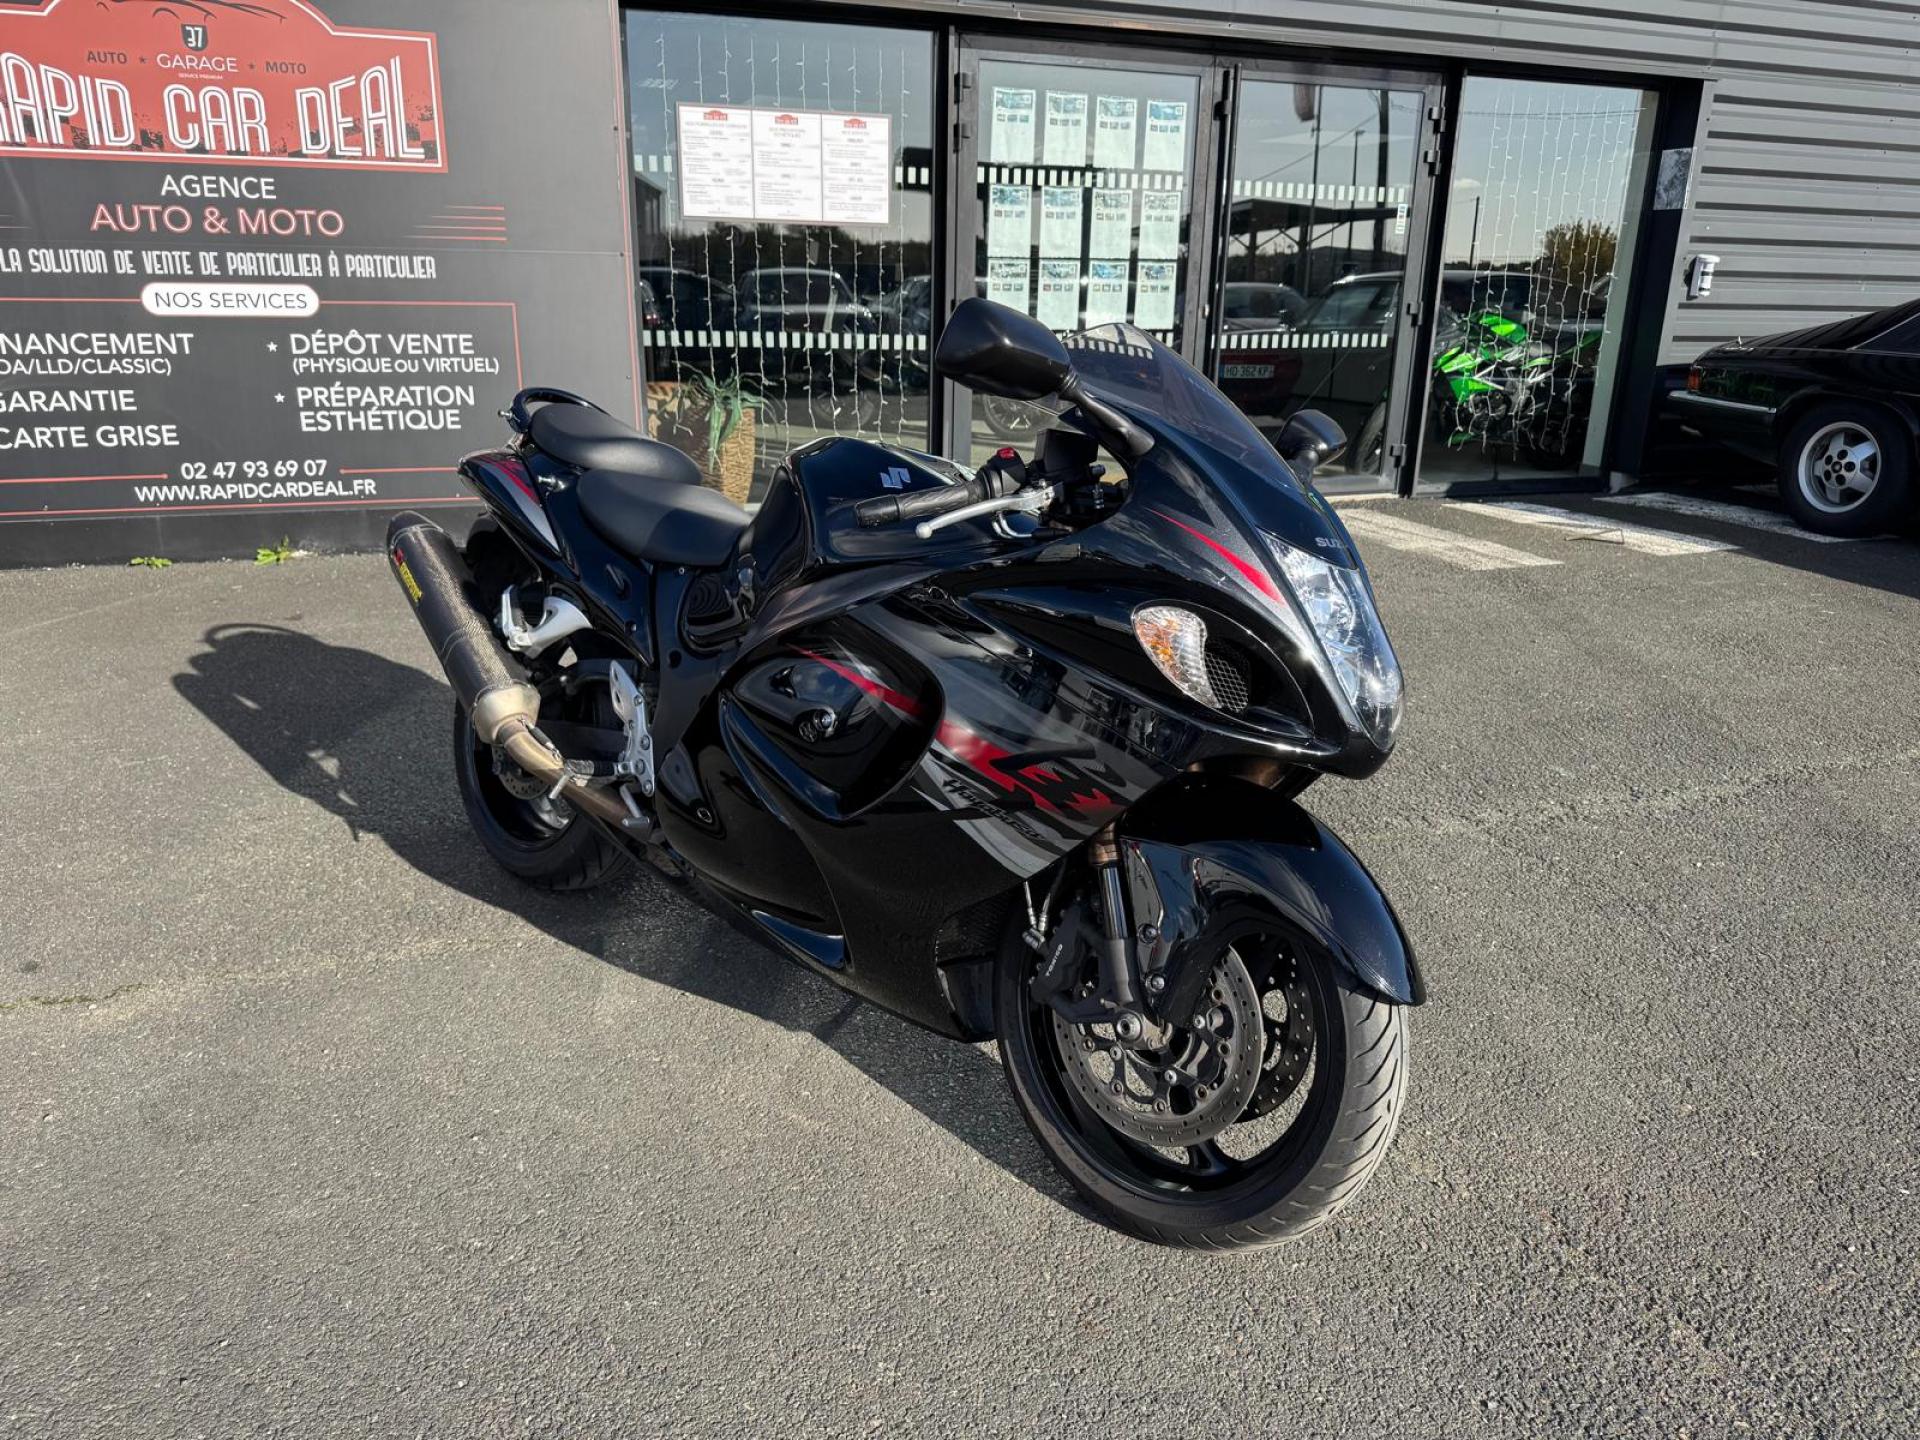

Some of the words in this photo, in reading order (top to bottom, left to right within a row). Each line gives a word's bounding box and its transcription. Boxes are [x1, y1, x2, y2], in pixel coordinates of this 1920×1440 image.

[185, 26, 202, 48] 37
[87, 51, 128, 65] AUTO
[156, 53, 239, 72] GARAGE
[265, 61, 307, 75] MOTO
[163, 83, 271, 154] CAR
[295, 55, 426, 159] DEAL
[161, 174, 276, 199] AGENCE
[90, 203, 192, 232] AUTO
[202, 206, 230, 234] &
[239, 209, 344, 237] MOTO
[0, 247, 23, 273] LA
[28, 248, 108, 274] SOLUTION
[114, 250, 136, 275] DE
[142, 251, 194, 275] VENTE
[200, 251, 221, 276] DE
[227, 252, 322, 278] PARTICULIER
[329, 251, 341, 278] À
[346, 255, 436, 280] PARTICULIER
[155, 292, 203, 309] NOS
[210, 293, 308, 311] SERVICES
[290, 329, 382, 355] DÉPÔT
[388, 334, 474, 355] VENTE
[293, 357, 392, 375] (PHYSIQUE
[394, 359, 418, 373] OU
[422, 357, 499, 375] VIRTUEL)
[297, 381, 475, 407] PRÉPARATION
[300, 405, 462, 432] ESTHÉTIQUE
[0, 426, 89, 449] CARTE
[96, 424, 180, 447] GRISE
[181, 462, 208, 480] 02
[213, 462, 236, 479] 47
[243, 461, 269, 479] 93
[274, 460, 299, 478] 69
[304, 460, 328, 477] 07
[134, 478, 377, 502] WWW.RAPIDCARDEAL.FR
